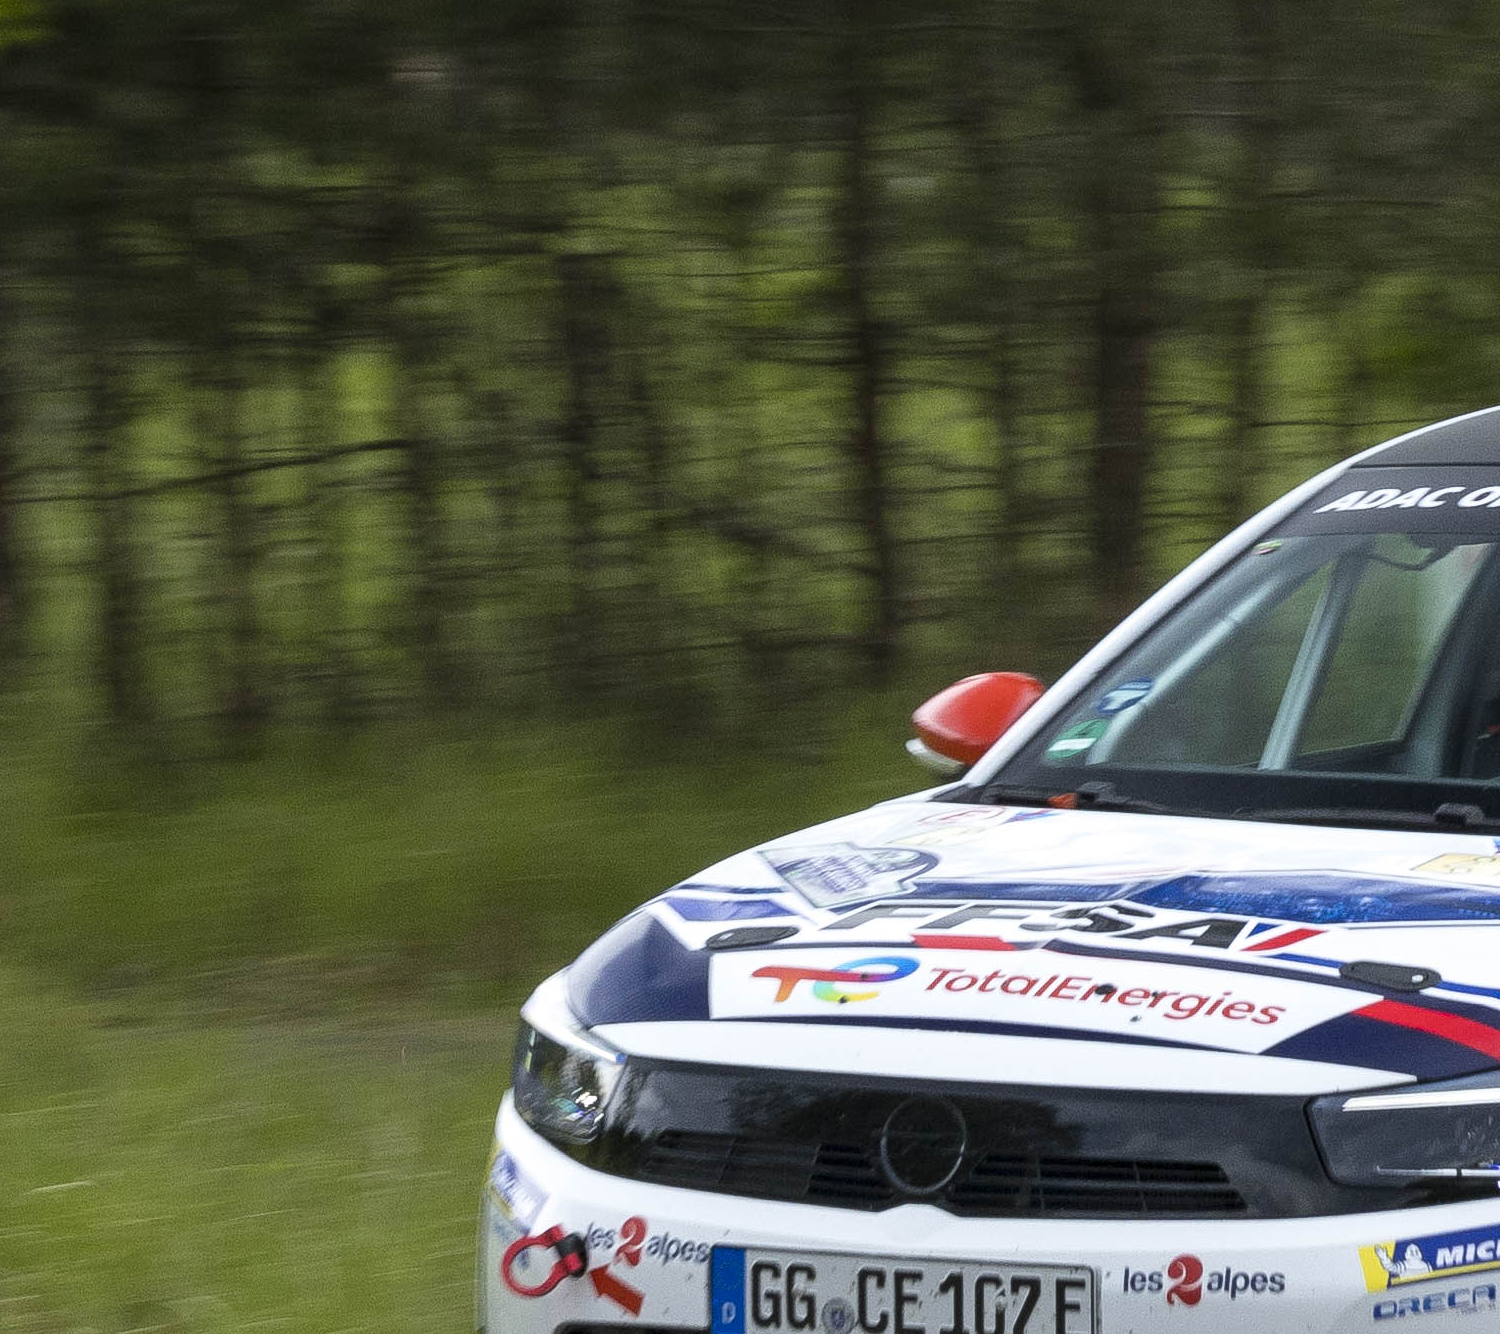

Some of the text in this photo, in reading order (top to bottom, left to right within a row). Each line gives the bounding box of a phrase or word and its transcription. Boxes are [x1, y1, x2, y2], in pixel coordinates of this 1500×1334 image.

[1313, 486, 1466, 514] ADAC
[818, 904, 1249, 951] FFSA
[924, 967, 1287, 1026] TotalEnergies
[750, 1259, 818, 1331] GG
[1123, 1253, 1286, 1307] les 2 alpes
[1373, 1284, 1497, 1321] ORECA
